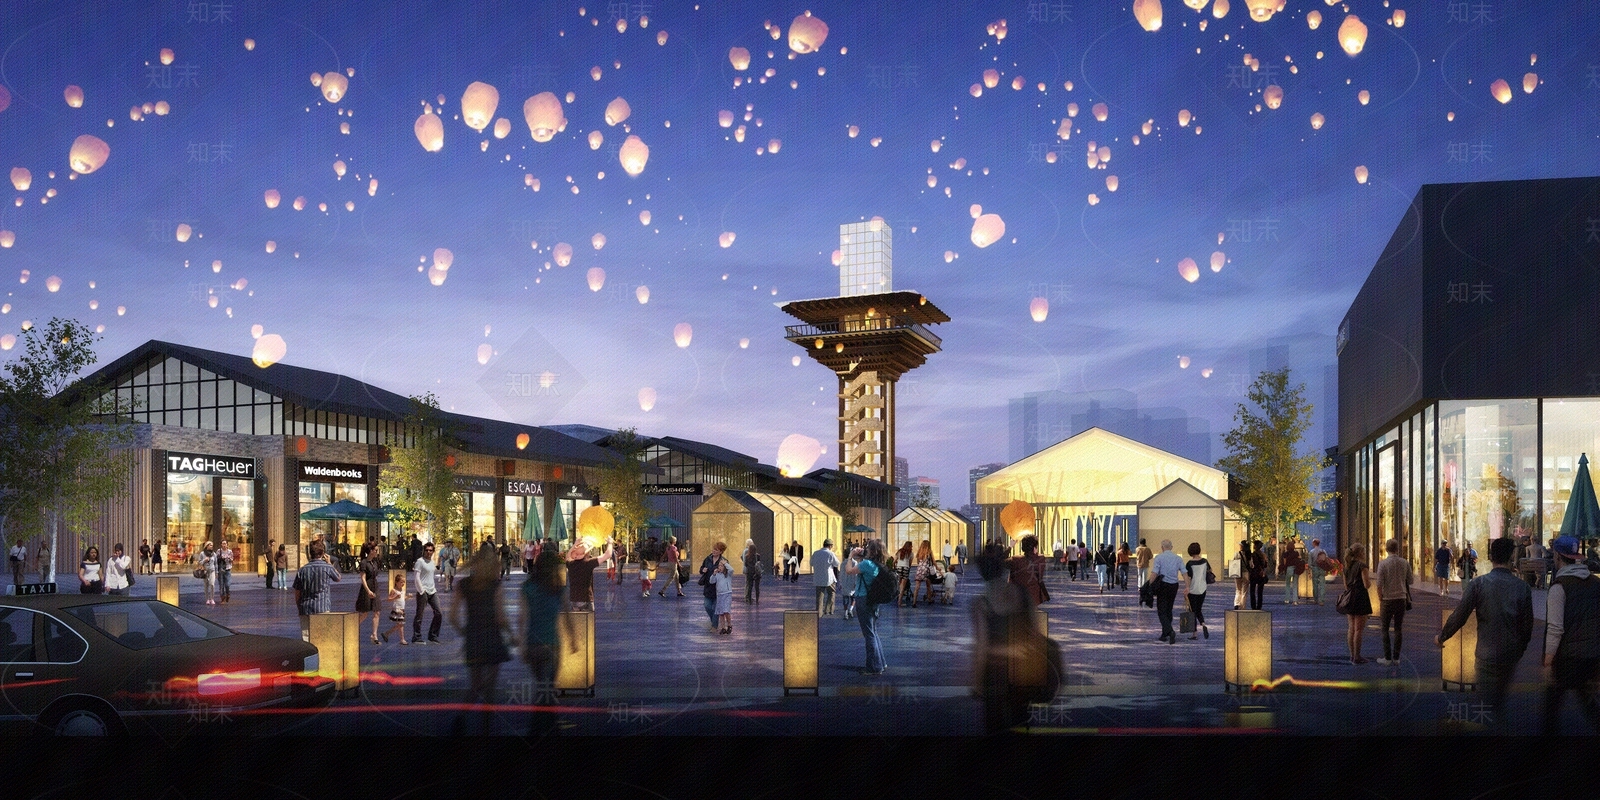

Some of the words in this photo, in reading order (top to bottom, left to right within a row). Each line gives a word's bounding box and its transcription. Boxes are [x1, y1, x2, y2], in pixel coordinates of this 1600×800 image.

[304, 465, 363, 479] Waldenbooks
[508, 481, 543, 495] ESCADA
[21, 584, 51, 594] TAXI
